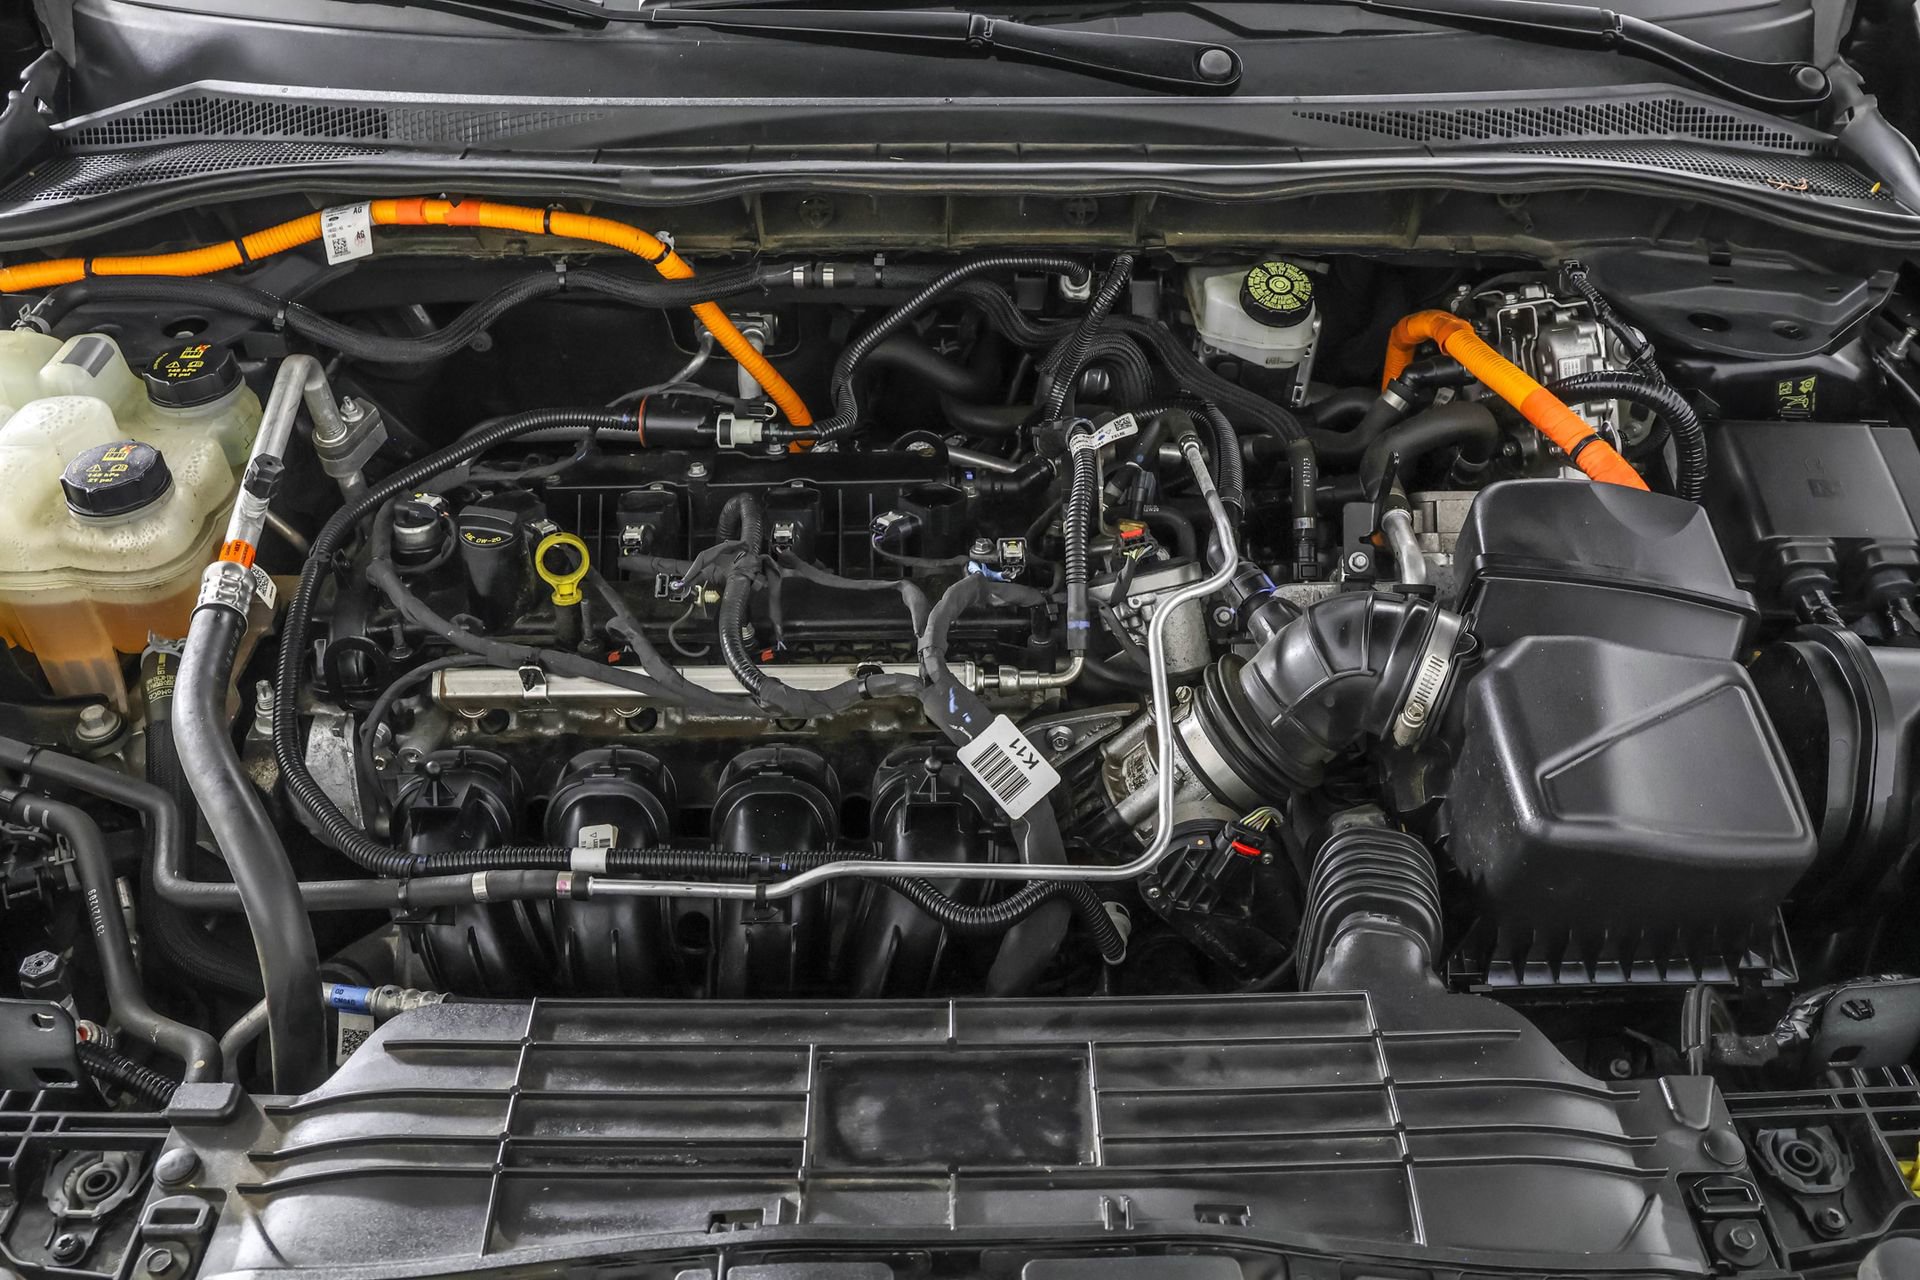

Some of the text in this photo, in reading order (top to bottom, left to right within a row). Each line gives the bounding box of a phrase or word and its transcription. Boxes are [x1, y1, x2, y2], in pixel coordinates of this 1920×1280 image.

[353, 206, 363, 215] AG
[356, 230, 366, 240] AG
[148, 688, 173, 701] oMoCo
[1008, 737, 1040, 770] K11
